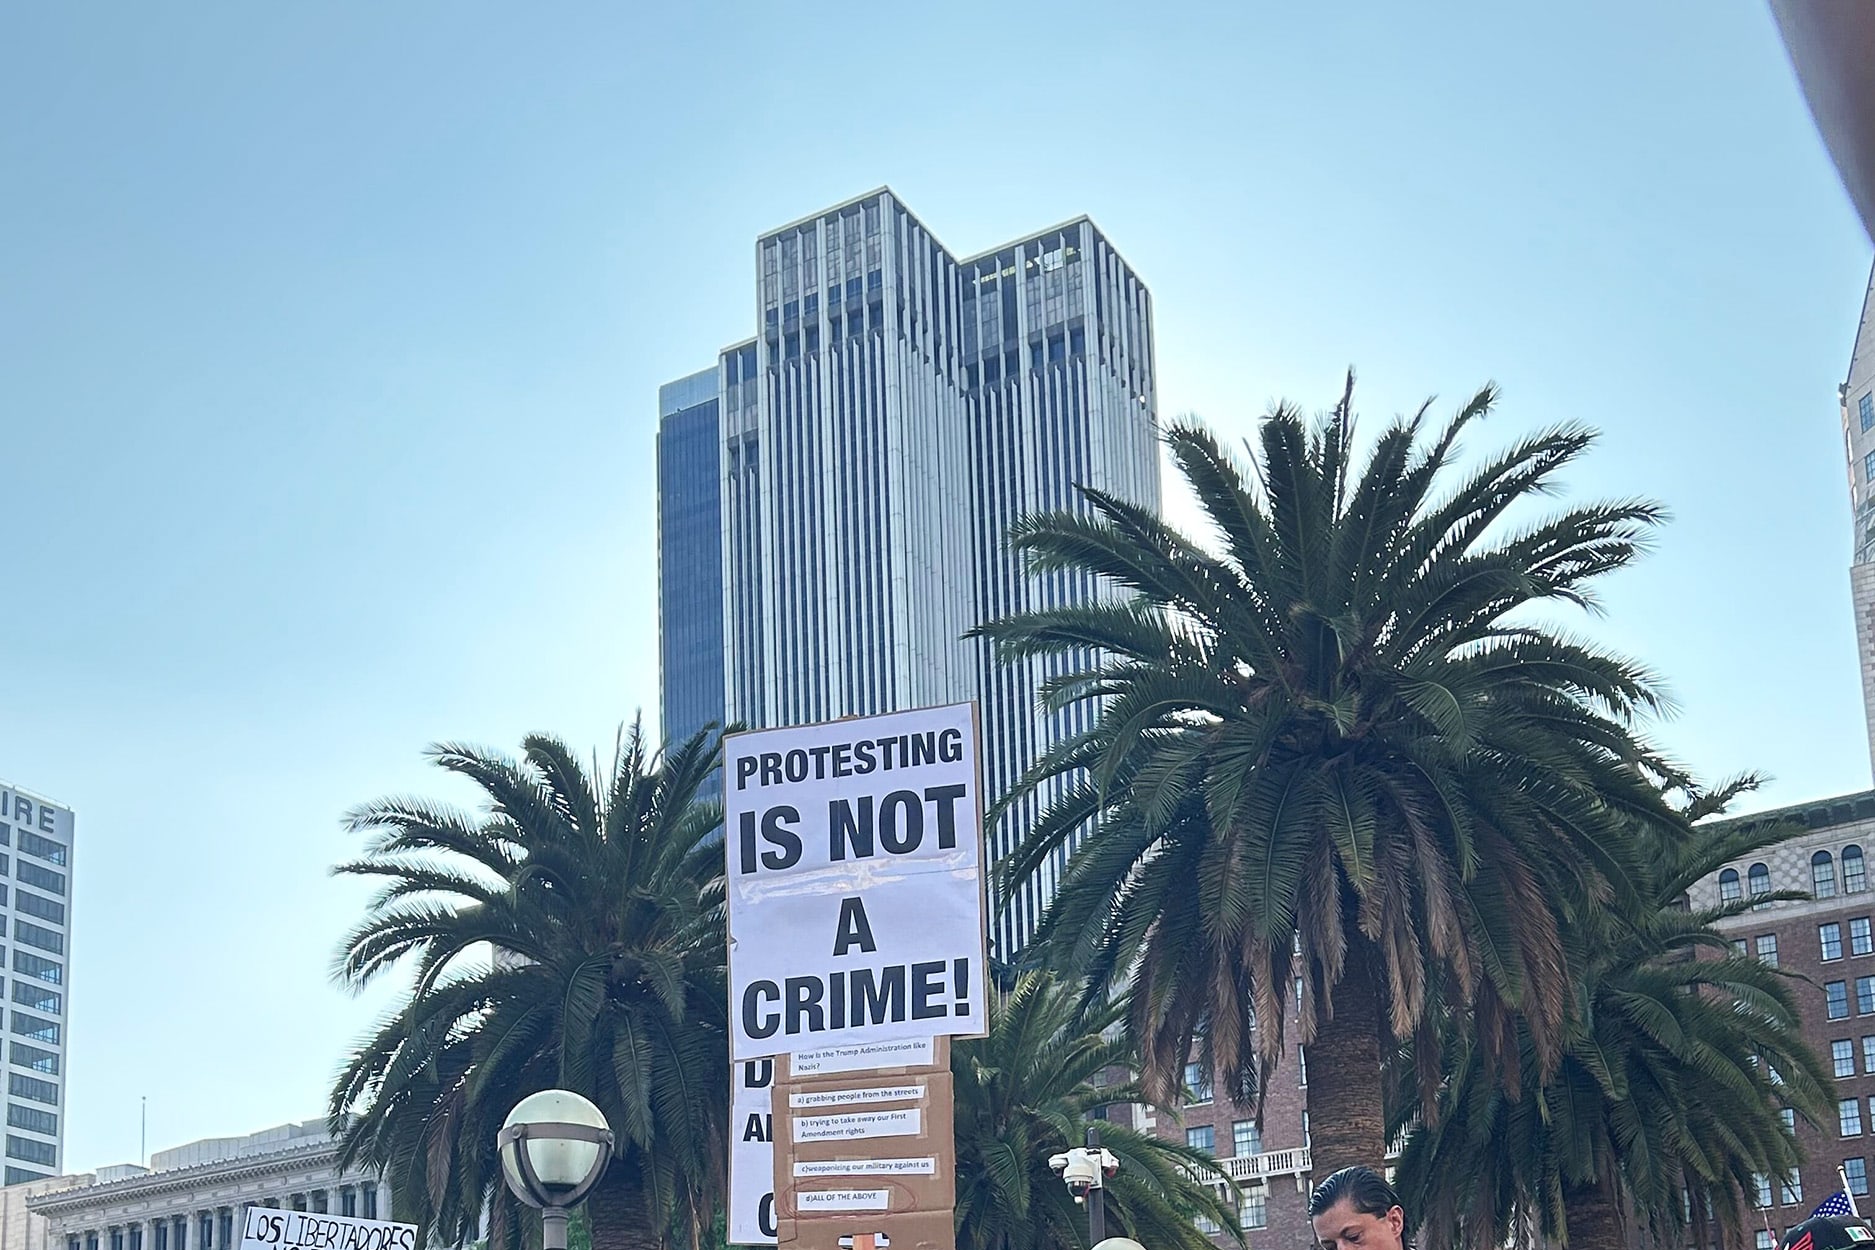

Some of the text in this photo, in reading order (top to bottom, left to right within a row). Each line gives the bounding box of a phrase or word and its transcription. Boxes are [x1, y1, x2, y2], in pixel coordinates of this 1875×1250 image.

[737, 728, 963, 791] PROTESTING
[739, 783, 967, 875] IS NOT
[832, 896, 877, 957] A
[741, 957, 970, 1040] CRIME!
[798, 1053, 814, 1061] How
[822, 1050, 834, 1058] the
[836, 1048, 859, 1058] Trump
[860, 1043, 911, 1054] Administration
[913, 1041, 926, 1049] like
[798, 1062, 820, 1071] Nazis?
[805, 1093, 836, 1104] grabbing
[837, 1091, 860, 1102] people
[862, 1090, 879, 1099] from
[880, 1088, 892, 1097] the
[894, 1088, 919, 1096] streets
[801, 1112, 906, 1129] b) trying to take away our First
[801, 1127, 865, 1138] Amendment rights
[865, 1161, 893, 1171] military
[894, 1160, 919, 1170] against
[826, 1193, 835, 1201] OF
[852, 1192, 877, 1200] ABOVE
[245, 1209, 284, 1243] LOS
